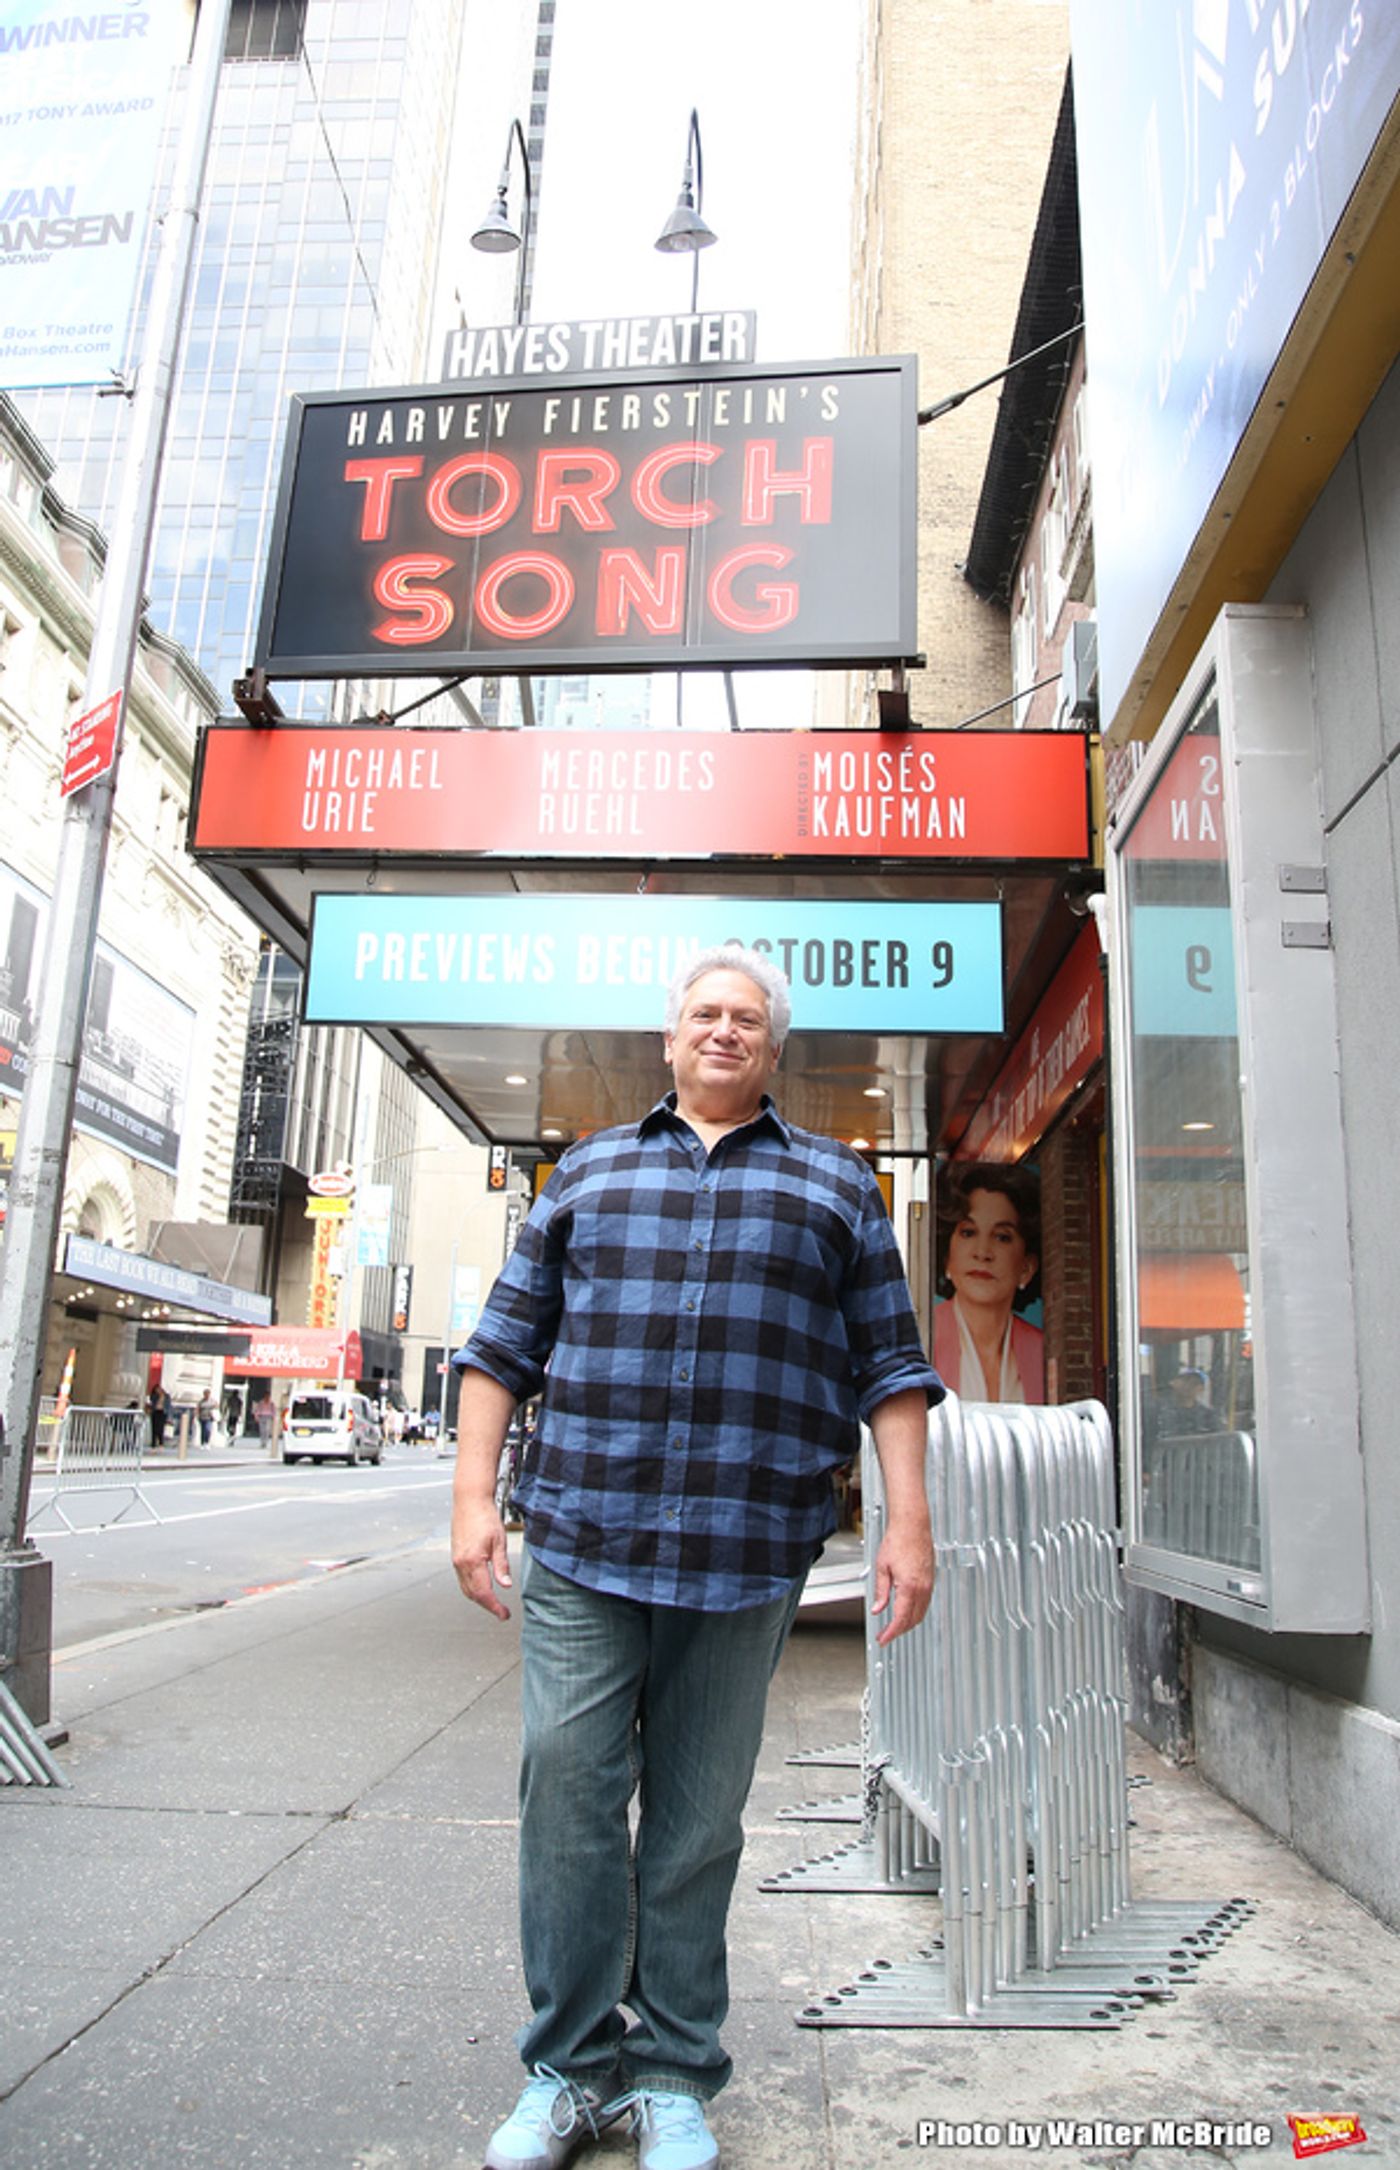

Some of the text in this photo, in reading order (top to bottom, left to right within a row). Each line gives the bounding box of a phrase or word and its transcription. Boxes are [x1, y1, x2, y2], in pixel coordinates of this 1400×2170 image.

[0, 12, 150, 53] WINNER
[1253, 0, 1310, 136] SU
[28, 102, 79, 122] TONY
[81, 96, 154, 116] AWARD
[1226, 231, 1267, 349] ONLY
[1284, 0, 1364, 208] BLOCKS
[449, 312, 748, 380] HAYES THEATER
[347, 385, 839, 446] HARVEY FIERSTEIN'S
[344, 435, 834, 542] TORCH
[370, 541, 799, 646] SONG
[305, 748, 444, 789] MICHAEL
[540, 749, 716, 792] MERCEDES
[813, 745, 936, 793] MOISÉS
[301, 792, 378, 833] URIE
[537, 793, 645, 836] RUEHL
[813, 796, 967, 839] KAUFMAN
[355, 932, 555, 983] PREVIEWS
[724, 938, 909, 988] TOBER
[931, 940, 954, 989] 9
